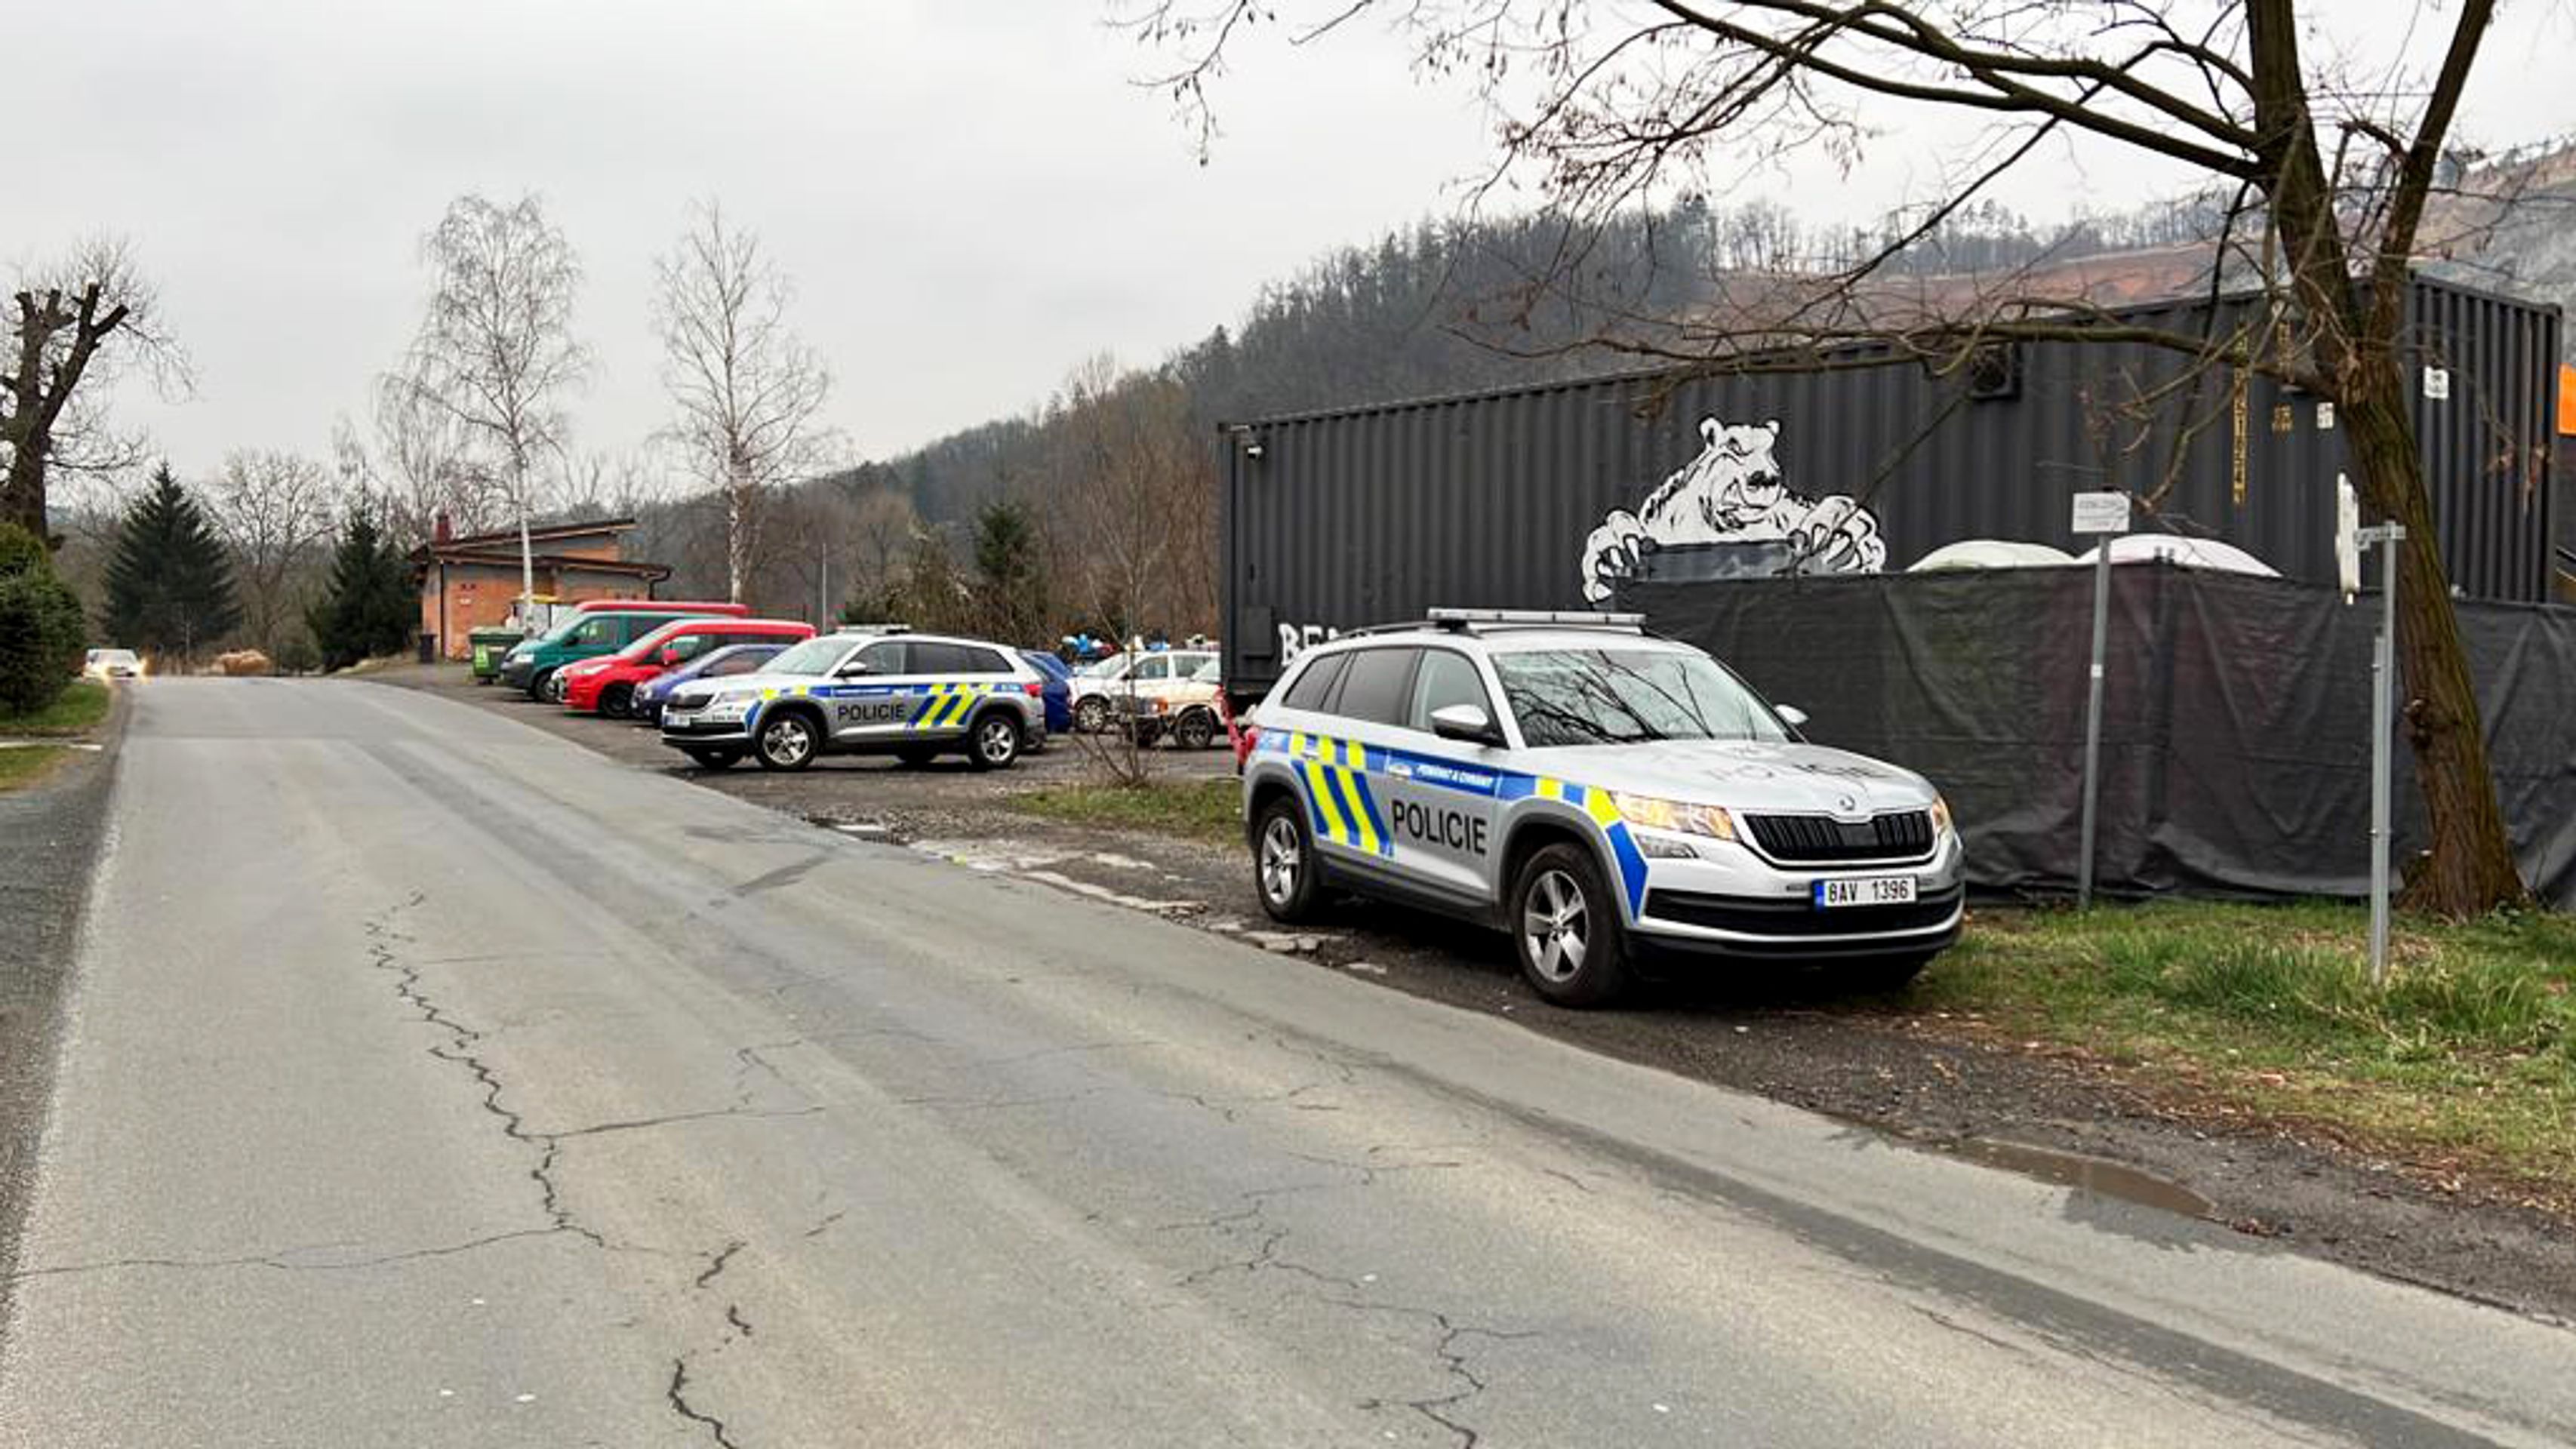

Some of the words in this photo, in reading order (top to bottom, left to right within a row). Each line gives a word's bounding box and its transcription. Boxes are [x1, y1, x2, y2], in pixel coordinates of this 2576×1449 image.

[837, 703, 906, 721] POLICIE
[1391, 798, 1488, 856] POLICIE
[1828, 881, 1858, 903] 8AV
[1872, 880, 1909, 901] 1396
